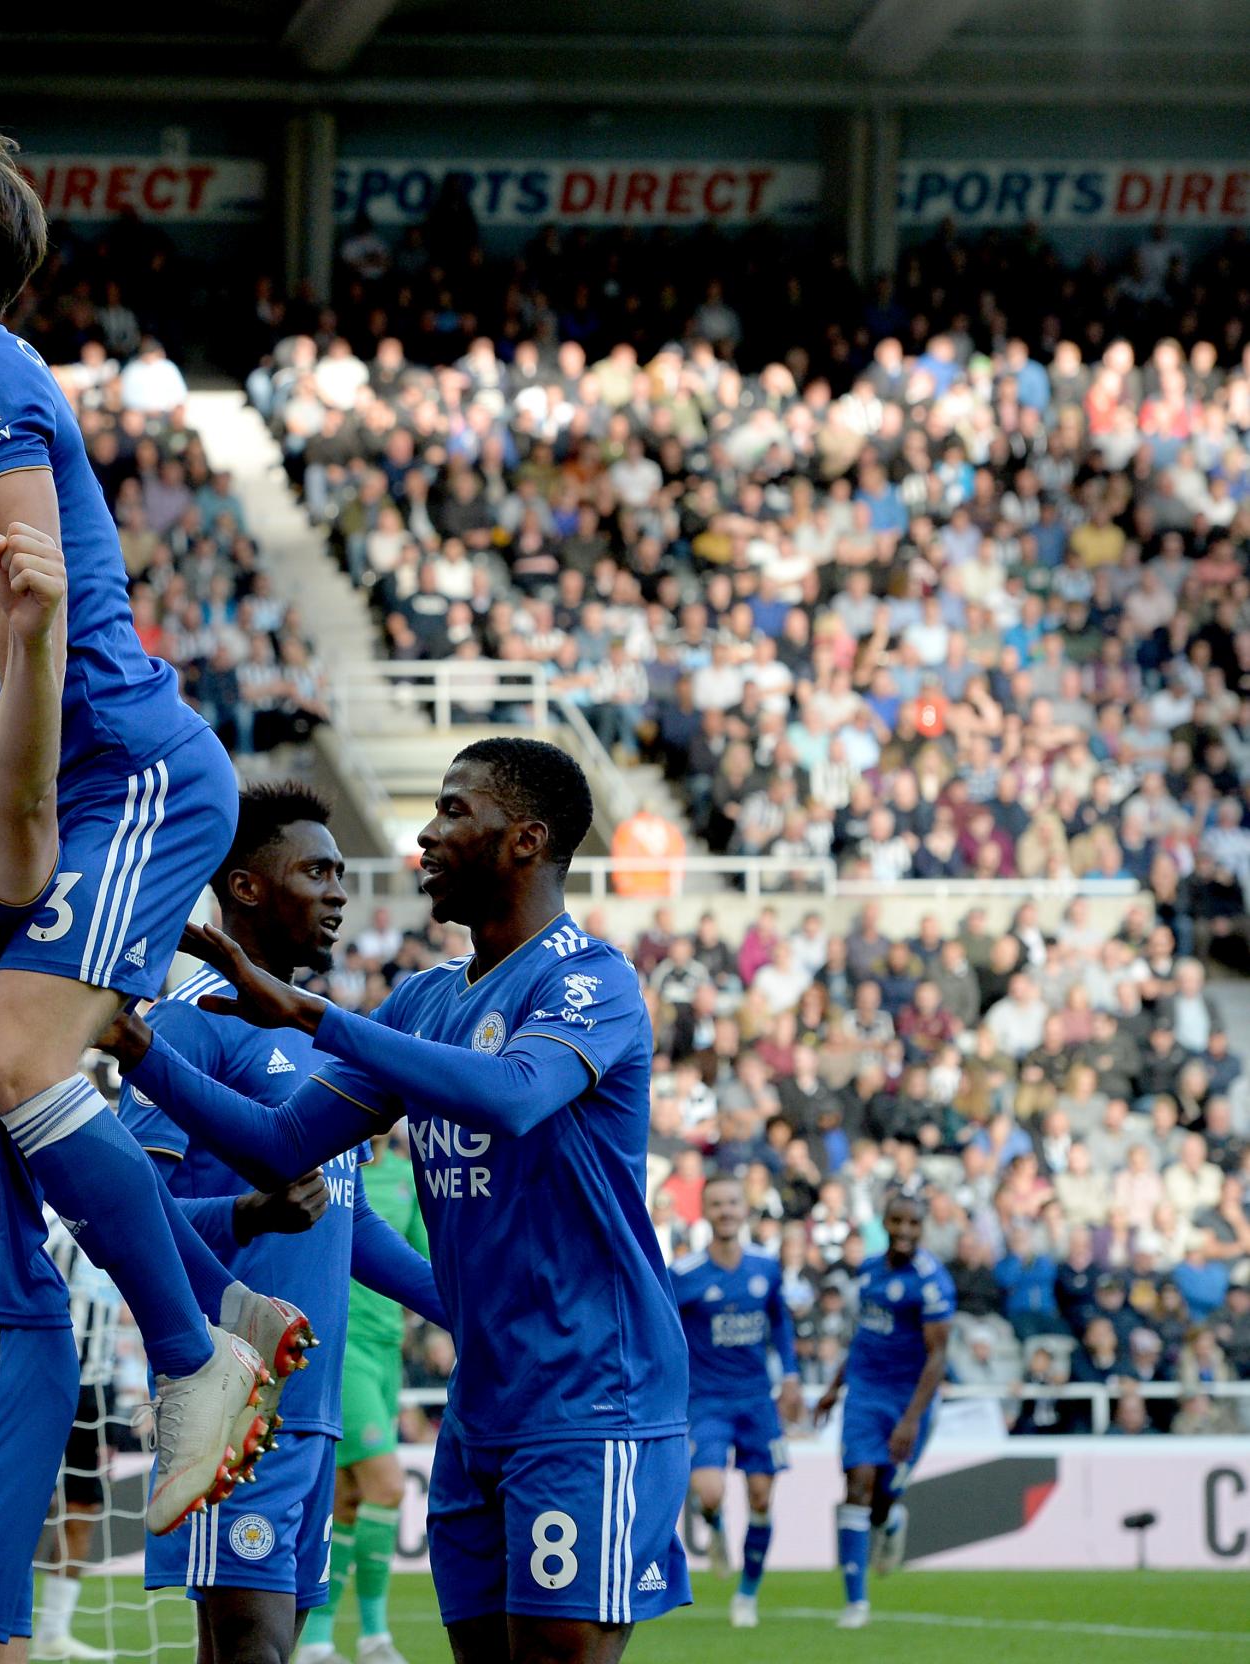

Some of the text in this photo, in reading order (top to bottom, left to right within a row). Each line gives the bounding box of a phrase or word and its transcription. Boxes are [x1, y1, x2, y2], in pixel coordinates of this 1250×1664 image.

[560, 170, 771, 213] DIRECT
[898, 173, 1103, 213] PORTS
[26, 872, 83, 942] 3
[266, 1063, 296, 1075] adidas
[409, 1117, 491, 1162] KNG
[425, 1166, 492, 1200] WER
[529, 1510, 578, 1590] 8
[637, 1580, 667, 1591] adidas
